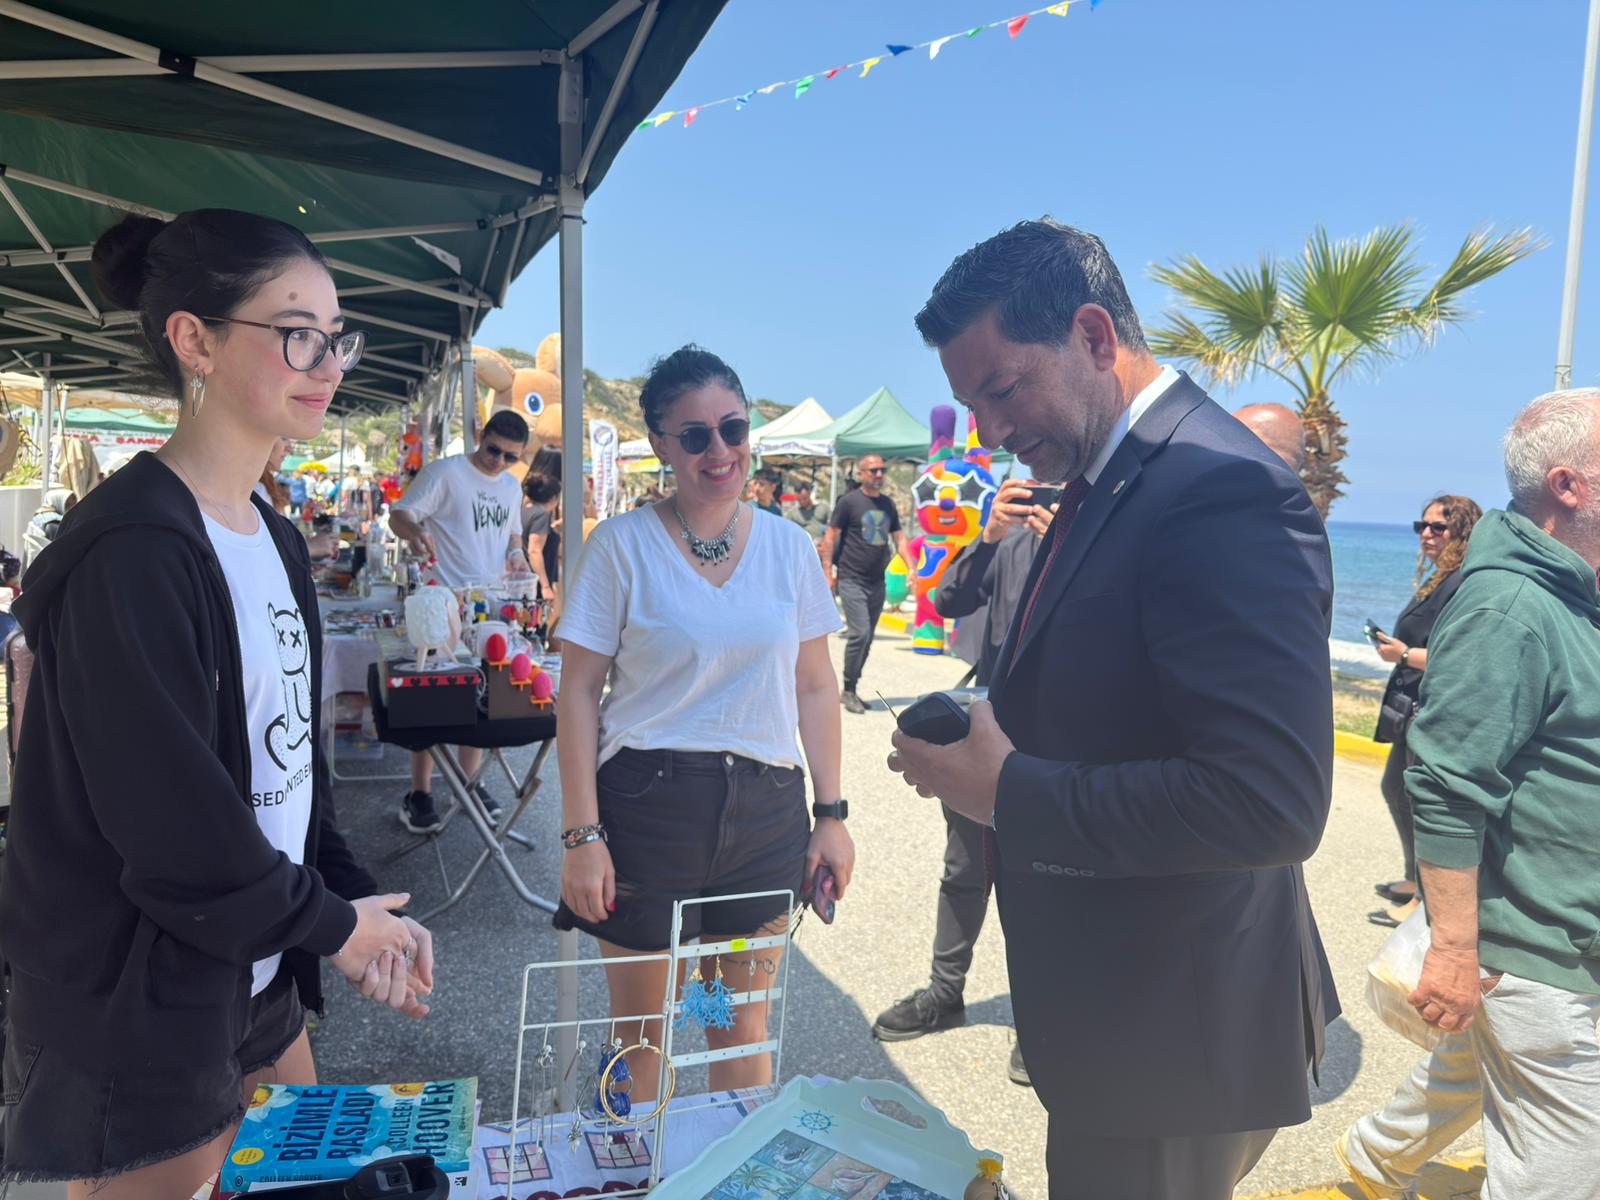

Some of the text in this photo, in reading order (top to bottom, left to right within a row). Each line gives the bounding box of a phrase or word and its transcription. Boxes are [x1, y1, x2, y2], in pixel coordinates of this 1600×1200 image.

[472, 501, 510, 533] VENOM
[272, 1089, 338, 1161] BİZİMLE
[326, 1092, 376, 1160] BAŞLADI
[387, 1098, 414, 1145] COLLEEN
[412, 1083, 455, 1157] HOOVER
